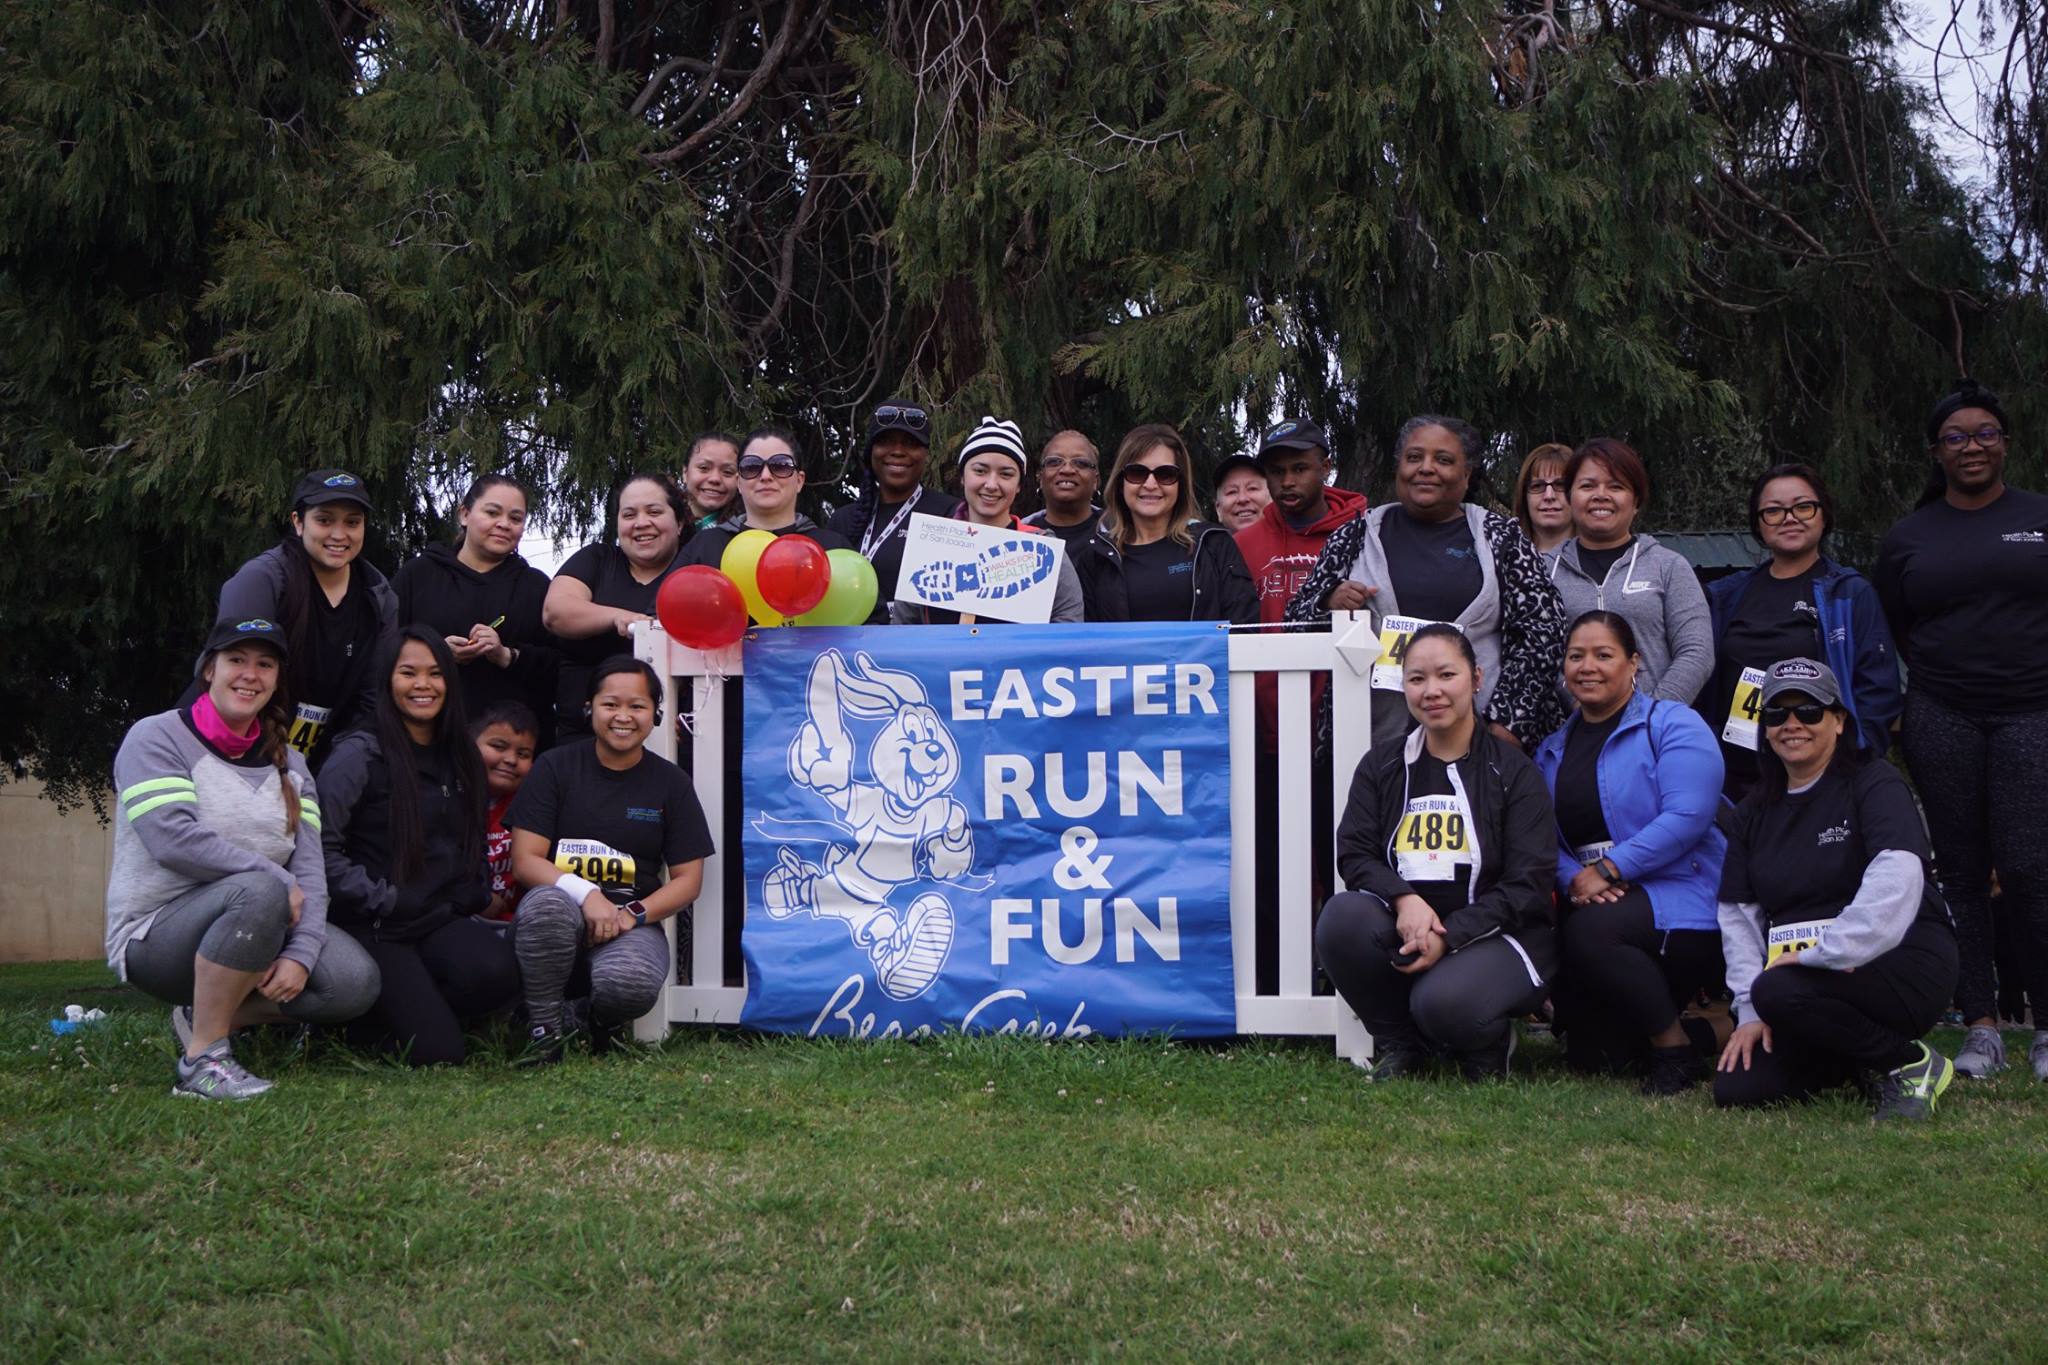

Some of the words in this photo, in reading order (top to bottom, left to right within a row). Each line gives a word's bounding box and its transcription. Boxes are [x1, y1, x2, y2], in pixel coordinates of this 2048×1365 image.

[921, 521, 948, 533] Health
[929, 533, 945, 543] San
[945, 537, 975, 549] Joaquin
[987, 562, 1036, 583] HEALTH
[1386, 619, 1415, 631] EASTER
[1744, 671, 1765, 685] EASTE
[948, 663, 1220, 722] EASTER
[984, 749, 1184, 820] RUN
[1407, 801, 1427, 813] ASTER
[1428, 800, 1447, 810] RUN
[1448, 801, 1455, 811] &
[1406, 812, 1465, 851] 489
[561, 843, 588, 854] EASTER
[590, 844, 607, 855] RUN
[1052, 825, 1115, 890] &
[990, 896, 1181, 965] FUN
[1771, 929, 1794, 943] EASTER
[1796, 926, 1812, 939] RUN
